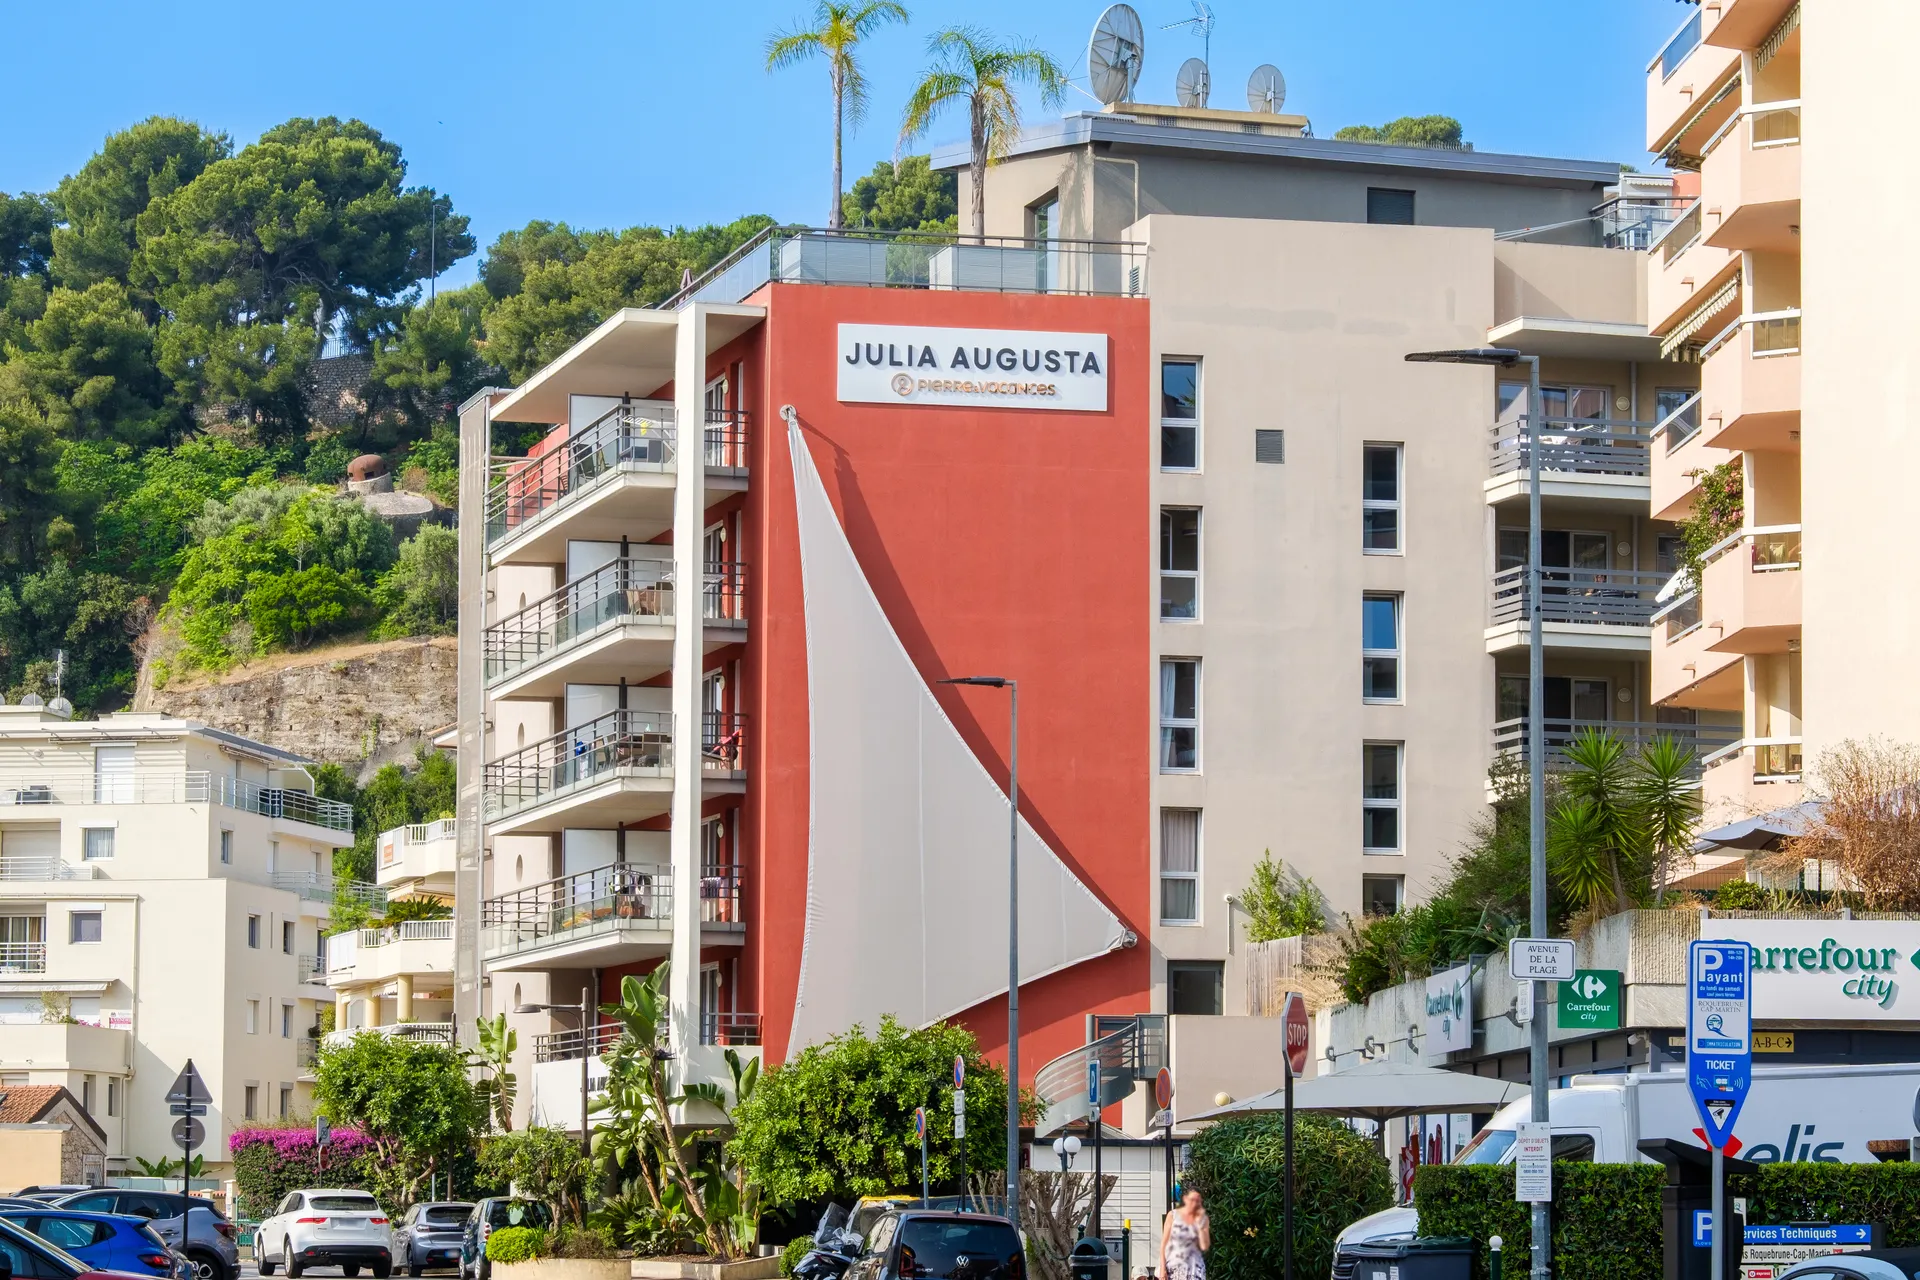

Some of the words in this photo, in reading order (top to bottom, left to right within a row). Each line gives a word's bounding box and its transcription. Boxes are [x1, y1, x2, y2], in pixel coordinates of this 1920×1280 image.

[846, 342, 937, 367] JULIA
[950, 347, 1100, 374] AUGUSTA
[1528, 945, 1559, 953] AVENUE
[1752, 938, 1896, 970] arrefour
[1529, 966, 1557, 974] PLAGE
[1842, 974, 1893, 1006] city
[1567, 1003, 1611, 1012] Carrefour
[1581, 1013, 1597, 1022] city
[1288, 1023, 1307, 1047] STOP
[1753, 1037, 1785, 1048] A-B-C
[1705, 1060, 1736, 1070] TICKET
[1742, 1124, 1844, 1164] elis
[1744, 1228, 1777, 1239] ervices
[1780, 1227, 1837, 1241] Techniques
[1750, 1248, 1831, 1262] Roquebrune-Cap-Martin
